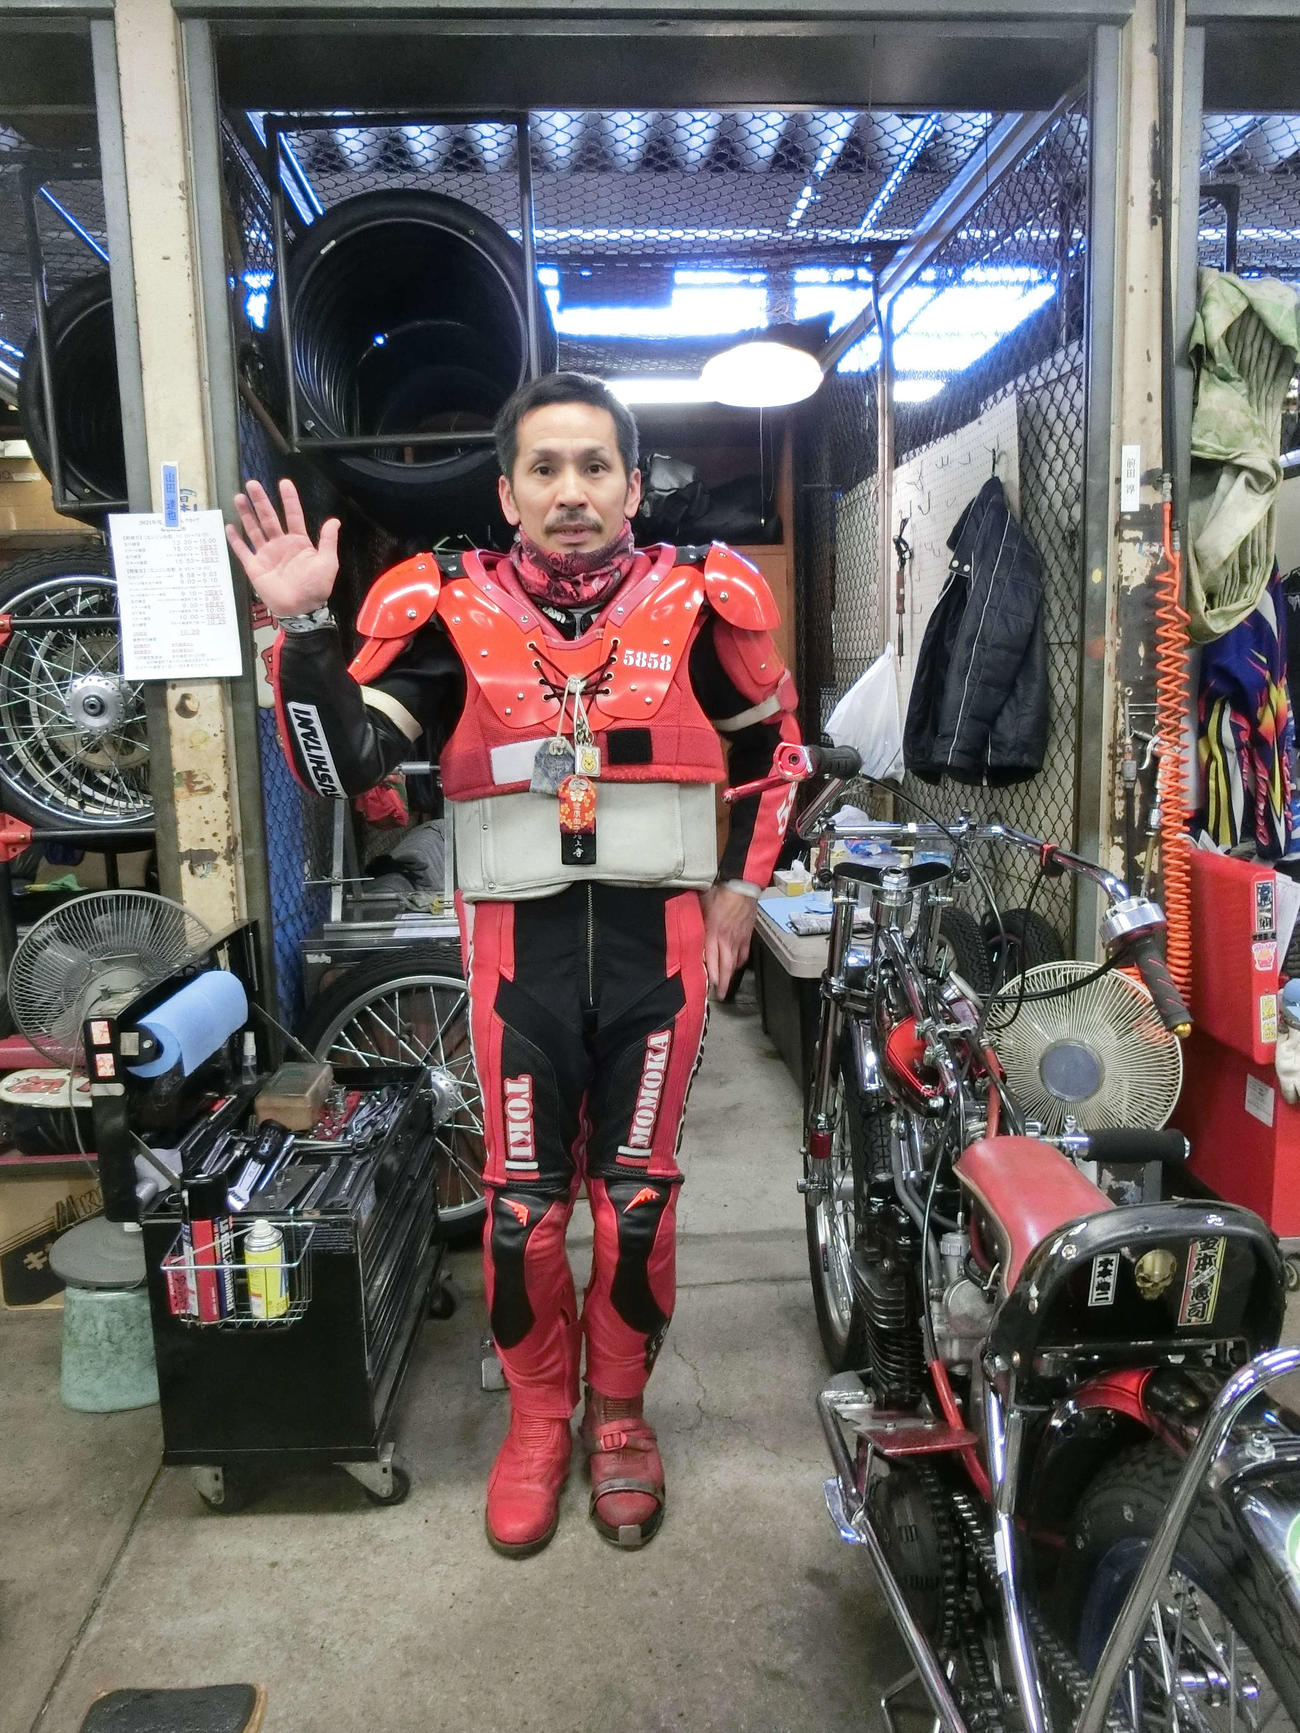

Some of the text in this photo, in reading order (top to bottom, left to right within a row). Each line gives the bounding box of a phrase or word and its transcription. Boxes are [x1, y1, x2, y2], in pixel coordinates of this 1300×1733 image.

[623, 650, 672, 671] 5858
[292, 707, 346, 800] USHITANI
[506, 1076, 533, 1158] TOKI
[630, 1032, 670, 1147] MOMOKA
